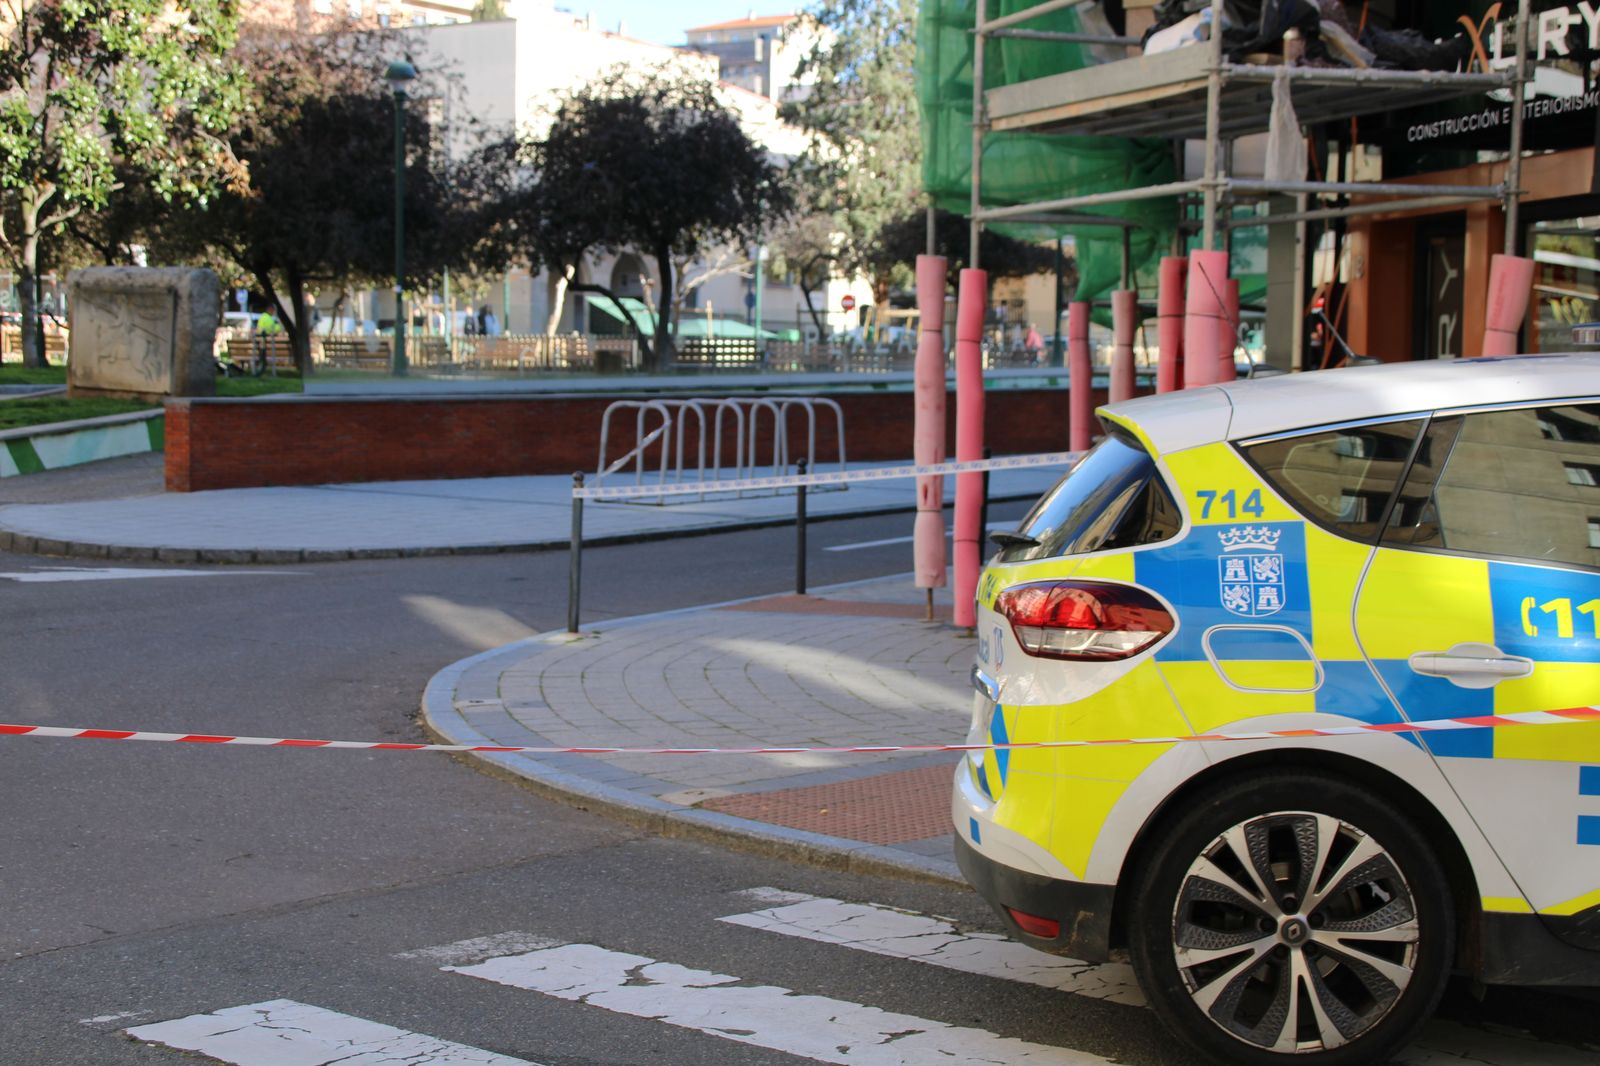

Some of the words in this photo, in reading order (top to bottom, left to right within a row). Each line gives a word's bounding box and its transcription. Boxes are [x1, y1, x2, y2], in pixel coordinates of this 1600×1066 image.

[1408, 109, 1499, 142] CONSTRUCCIÓN
[1503, 108, 1511, 124] E
[1521, 91, 1600, 121] TERIORISMO
[1196, 488, 1264, 519] 714
